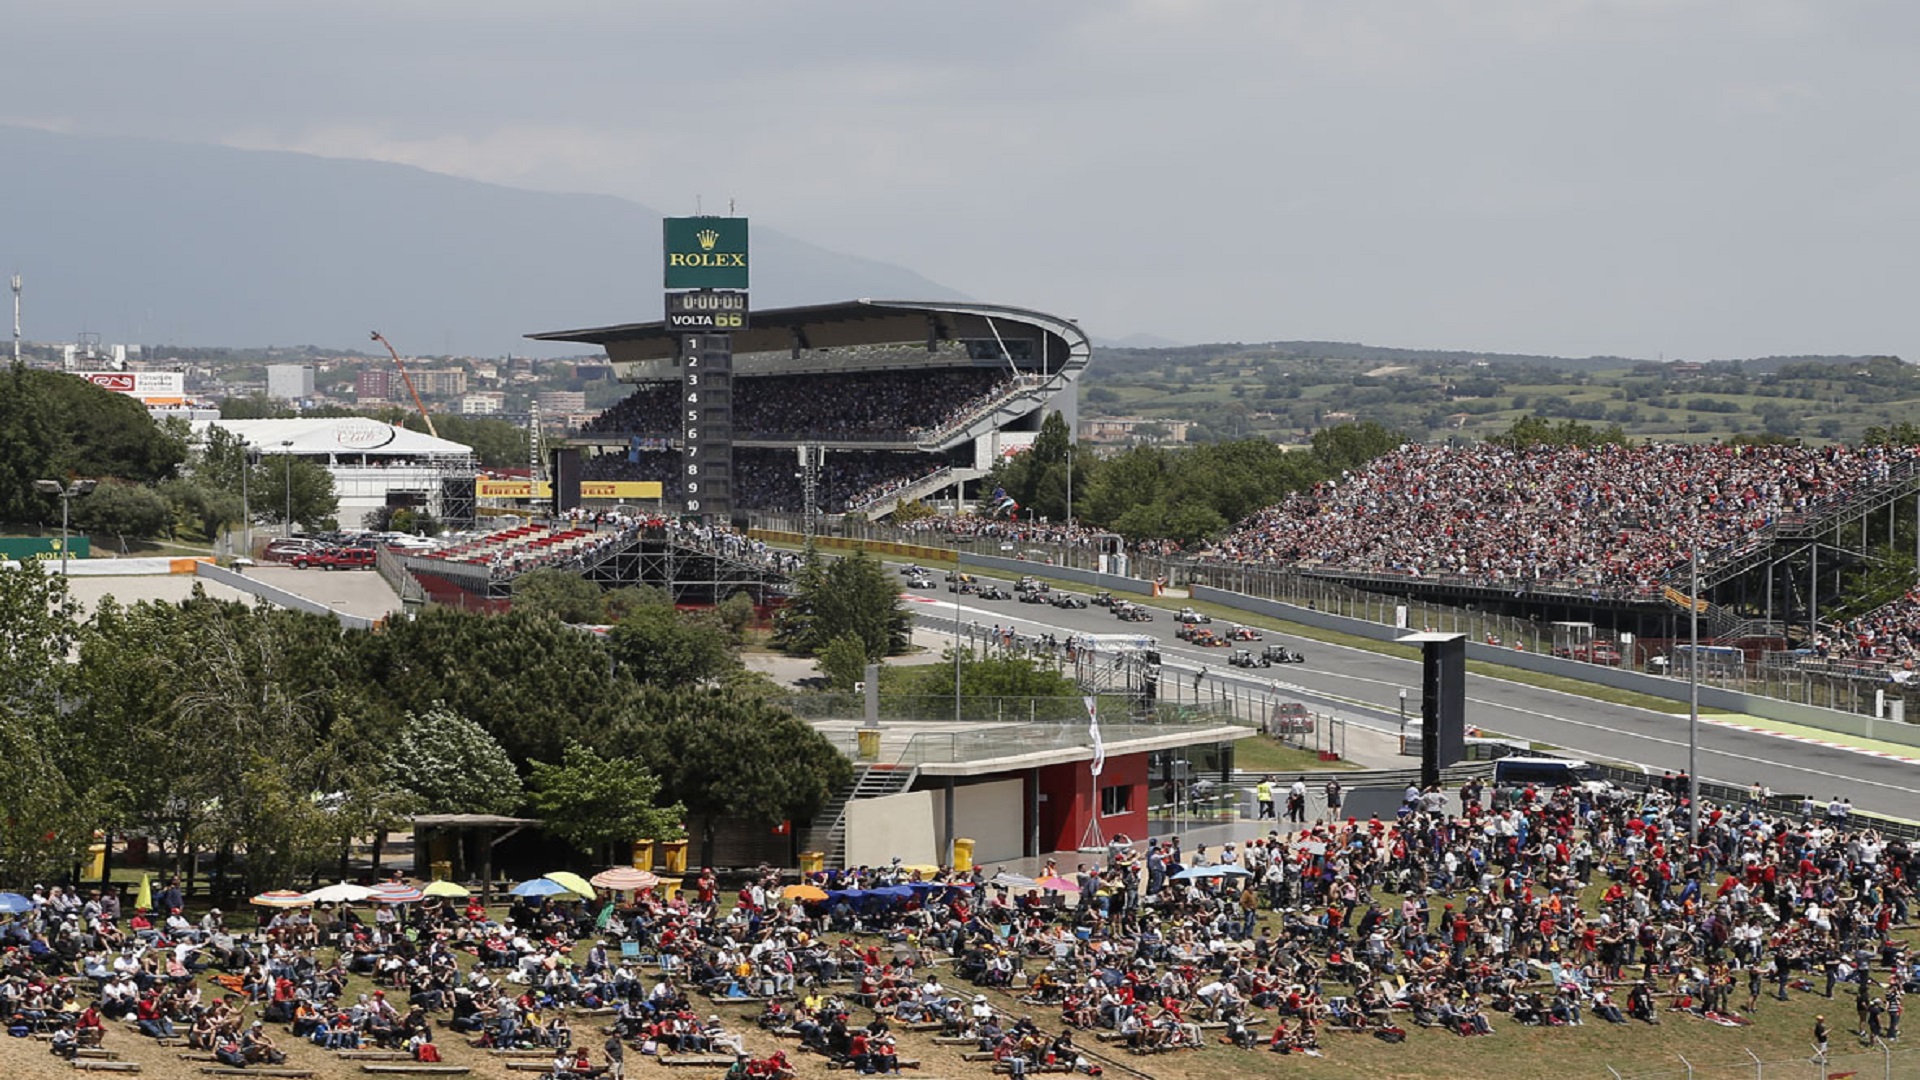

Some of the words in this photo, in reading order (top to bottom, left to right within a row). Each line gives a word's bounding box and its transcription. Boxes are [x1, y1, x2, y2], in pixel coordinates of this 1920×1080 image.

[669, 253, 746, 267] ROLEX
[683, 294, 743, 309] 0:00:00
[672, 315, 713, 325] VOLTA
[714, 312, 742, 327] 66
[688, 338, 697, 349] 1
[688, 356, 698, 367] 2
[688, 374, 698, 385] 3
[688, 392, 698, 403] 4
[688, 410, 698, 421] 5
[688, 428, 698, 439] 6
[688, 446, 698, 457] 7
[688, 464, 698, 475] 8
[688, 482, 698, 493] 9
[687, 500, 700, 511] 10
